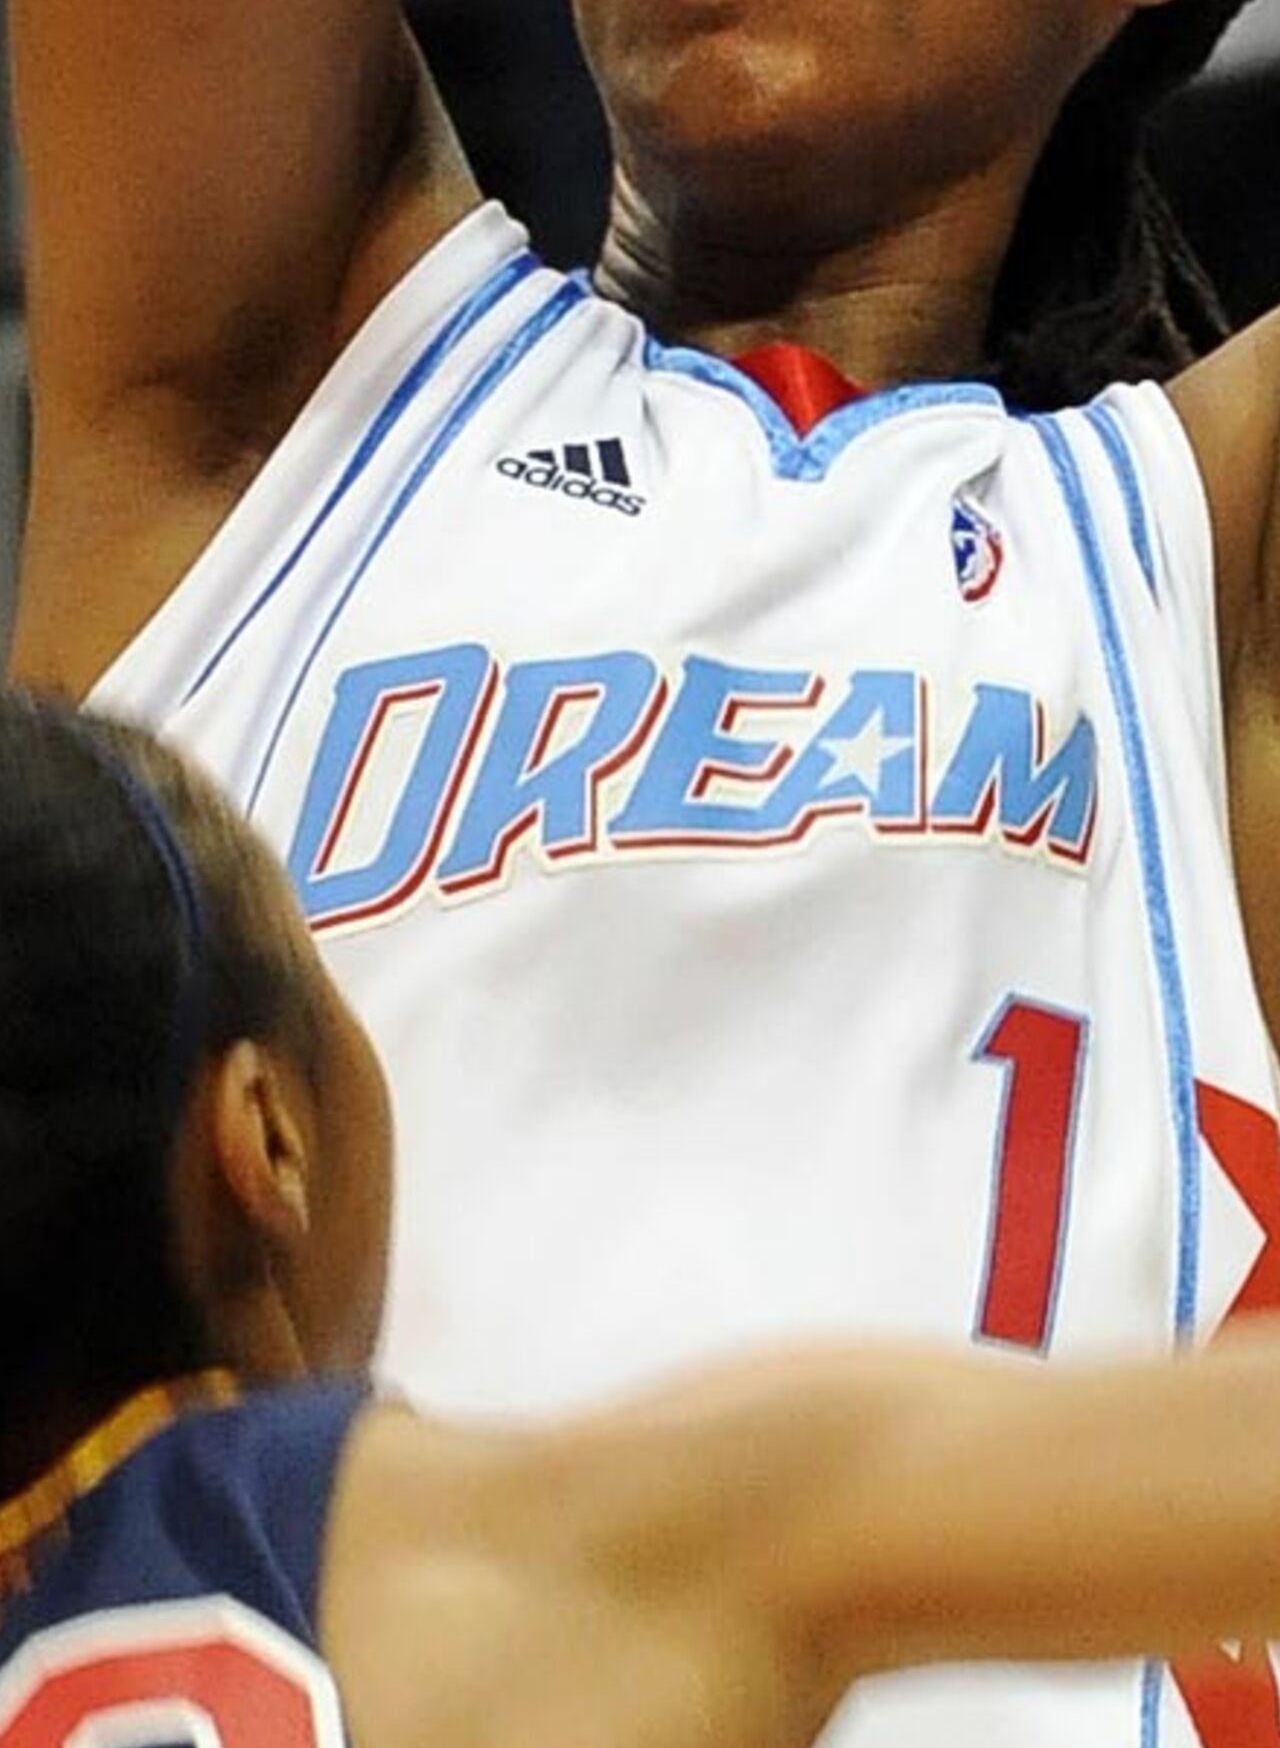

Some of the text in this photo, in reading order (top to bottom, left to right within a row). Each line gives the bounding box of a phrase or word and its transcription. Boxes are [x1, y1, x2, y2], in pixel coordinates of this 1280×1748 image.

[496, 457, 646, 517] adidas
[287, 642, 1100, 938] DREAM
[971, 992, 1090, 1360] 1
